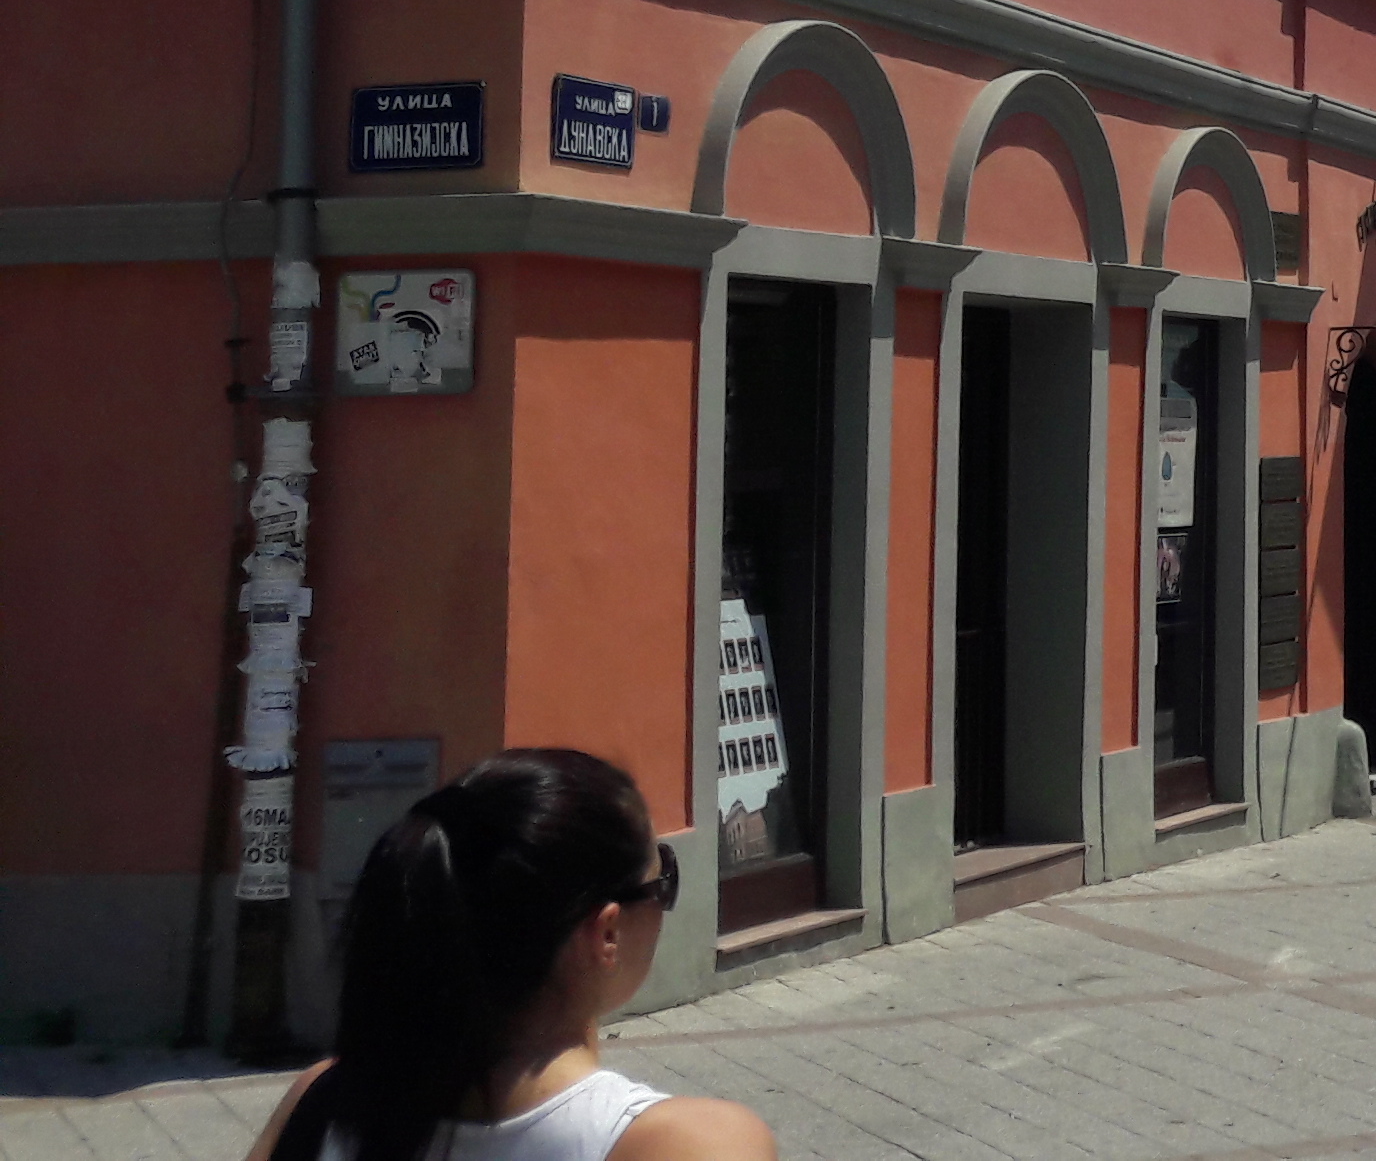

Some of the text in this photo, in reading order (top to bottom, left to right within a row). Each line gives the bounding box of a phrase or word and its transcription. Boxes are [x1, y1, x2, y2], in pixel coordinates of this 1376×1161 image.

[376, 92, 454, 112] УЛИЦА
[575, 95, 617, 117] УЛИЦА
[362, 121, 471, 161] ГИМНАЗИЈСКА
[559, 118, 630, 162] ДУНАВСКА
